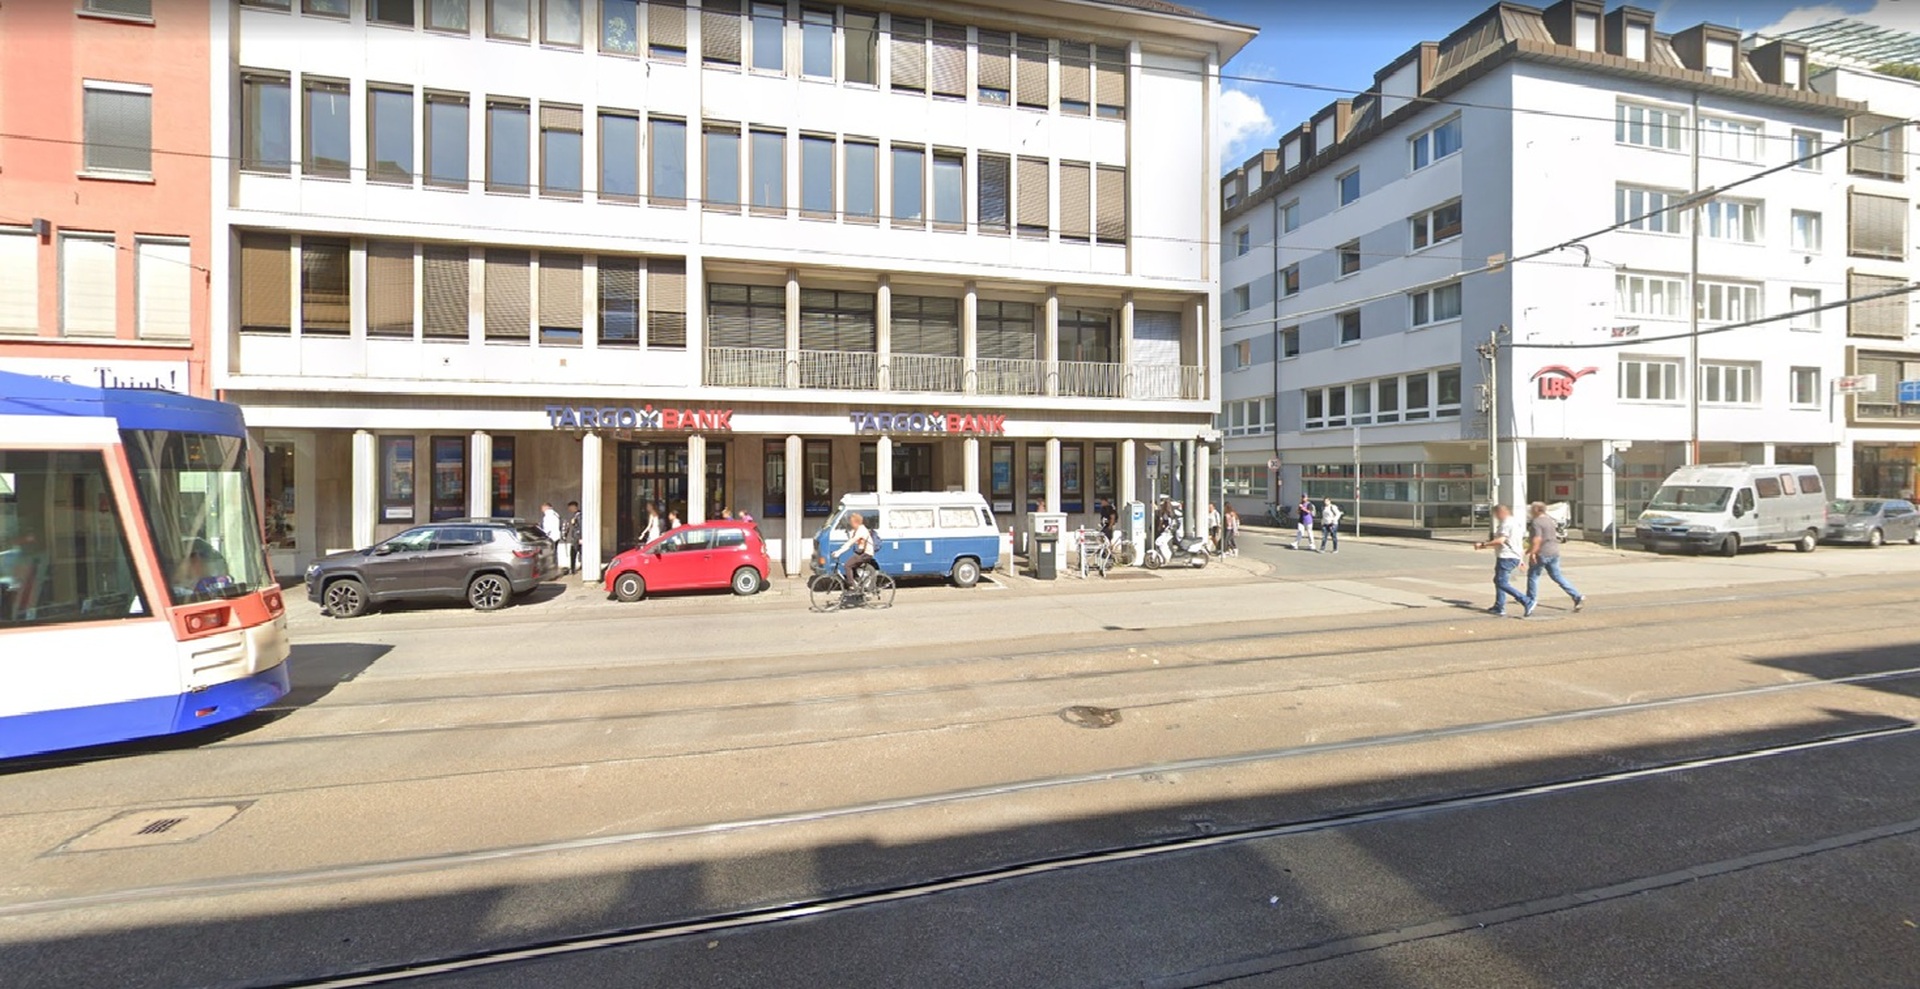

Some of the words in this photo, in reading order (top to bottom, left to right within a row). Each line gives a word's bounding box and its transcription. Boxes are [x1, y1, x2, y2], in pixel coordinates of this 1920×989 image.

[93, 366, 176, 390] Think!
[1540, 377, 1574, 398] LBS
[545, 404, 637, 429] TARGO
[662, 408, 733, 431] BANK
[850, 411, 925, 434] TARGO
[946, 412, 1007, 435] BANK
